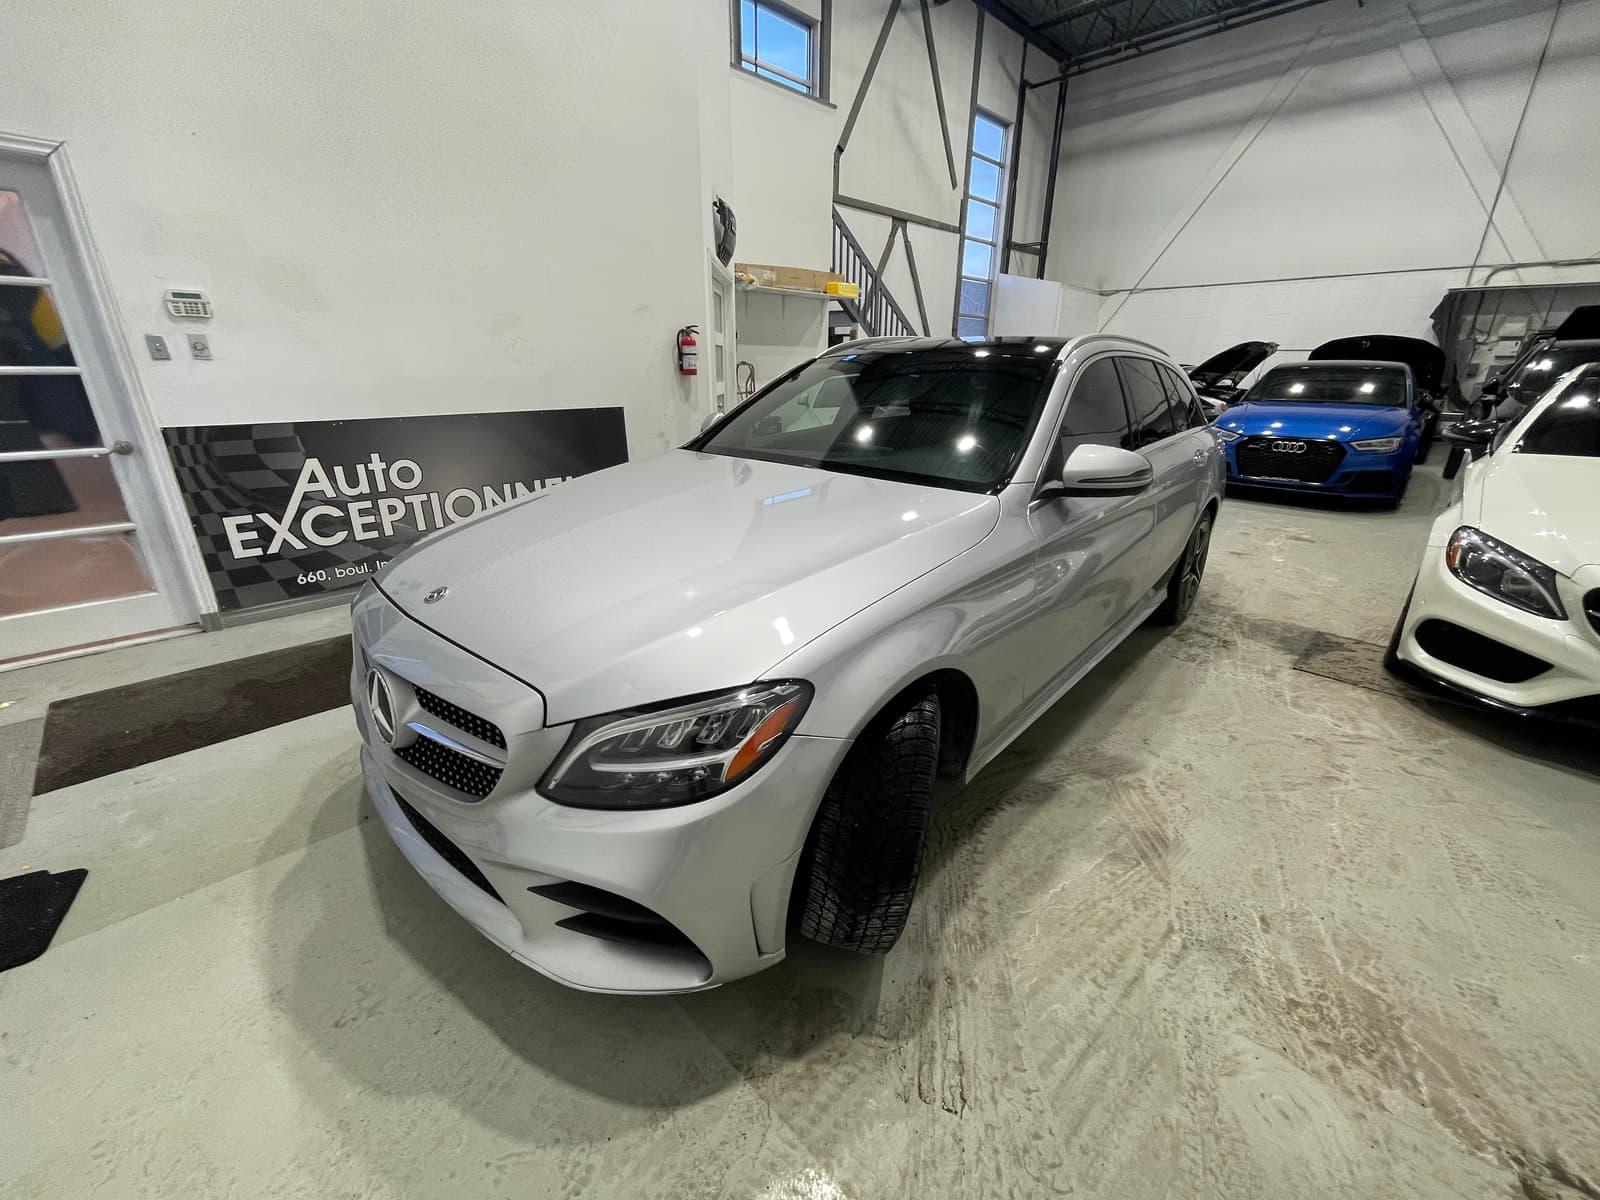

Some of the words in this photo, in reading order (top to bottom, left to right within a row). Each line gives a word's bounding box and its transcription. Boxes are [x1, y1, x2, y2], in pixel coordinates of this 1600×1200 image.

[290, 452, 423, 500] Auto
[222, 475, 573, 559] EXCEPTION
[297, 570, 332, 585] 660,
[335, 562, 372, 578] boul.
